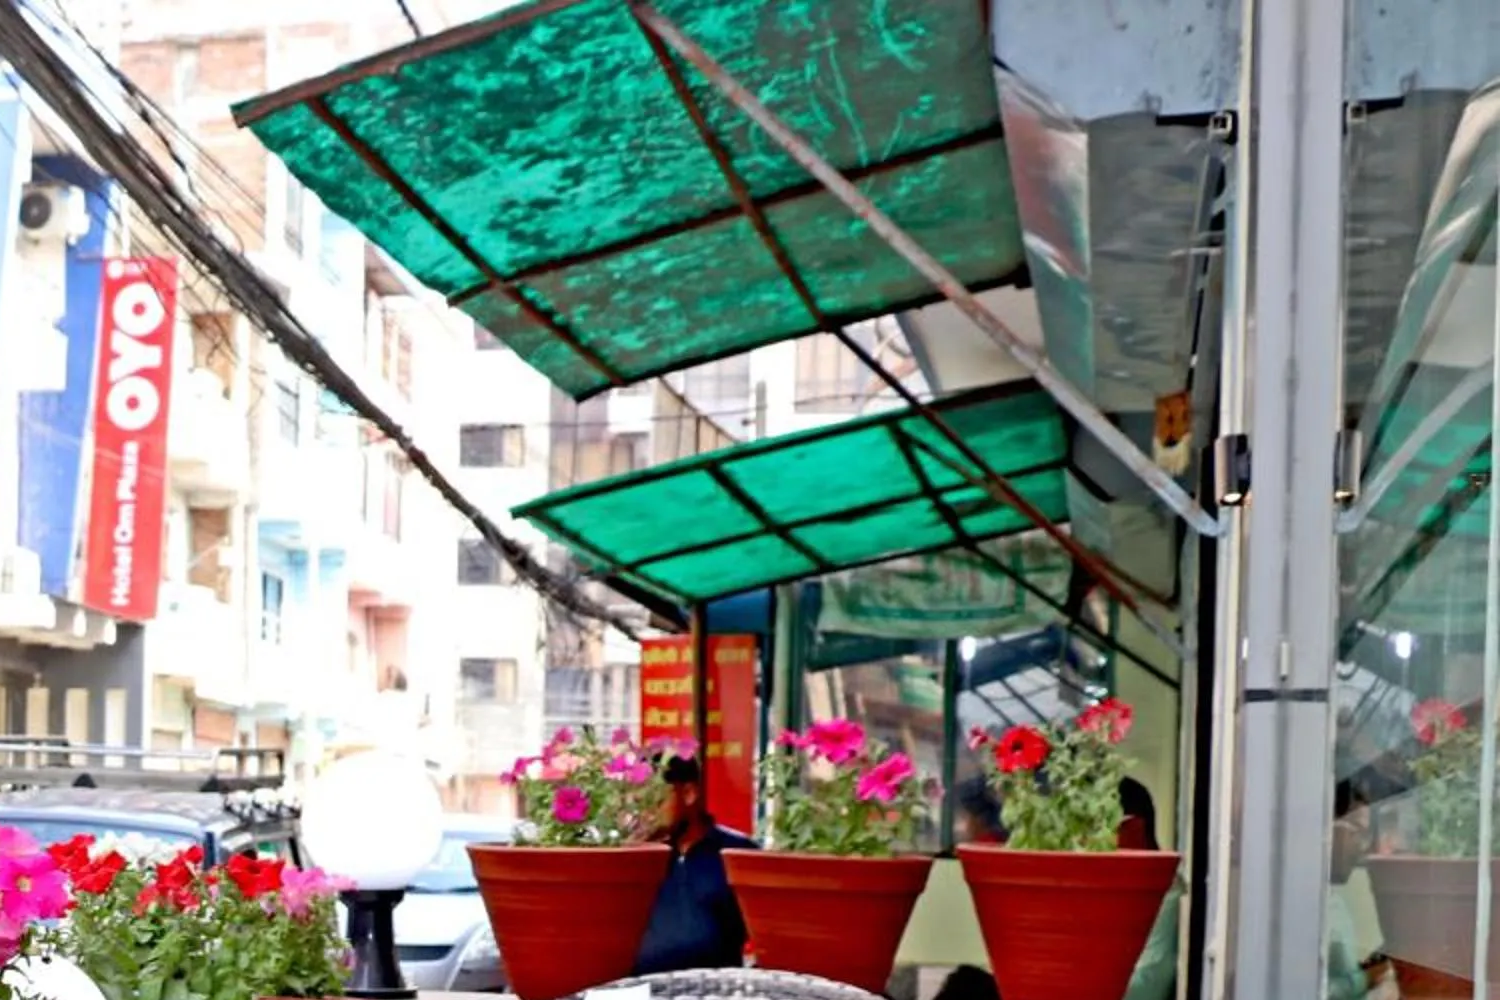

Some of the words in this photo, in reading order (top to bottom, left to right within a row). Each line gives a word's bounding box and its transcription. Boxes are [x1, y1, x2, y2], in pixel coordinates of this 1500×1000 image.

[106, 282, 165, 430] OYO
[116, 441, 139, 500] Plaza
[113, 503, 135, 543] Om
[111, 546, 133, 607] Hotel
